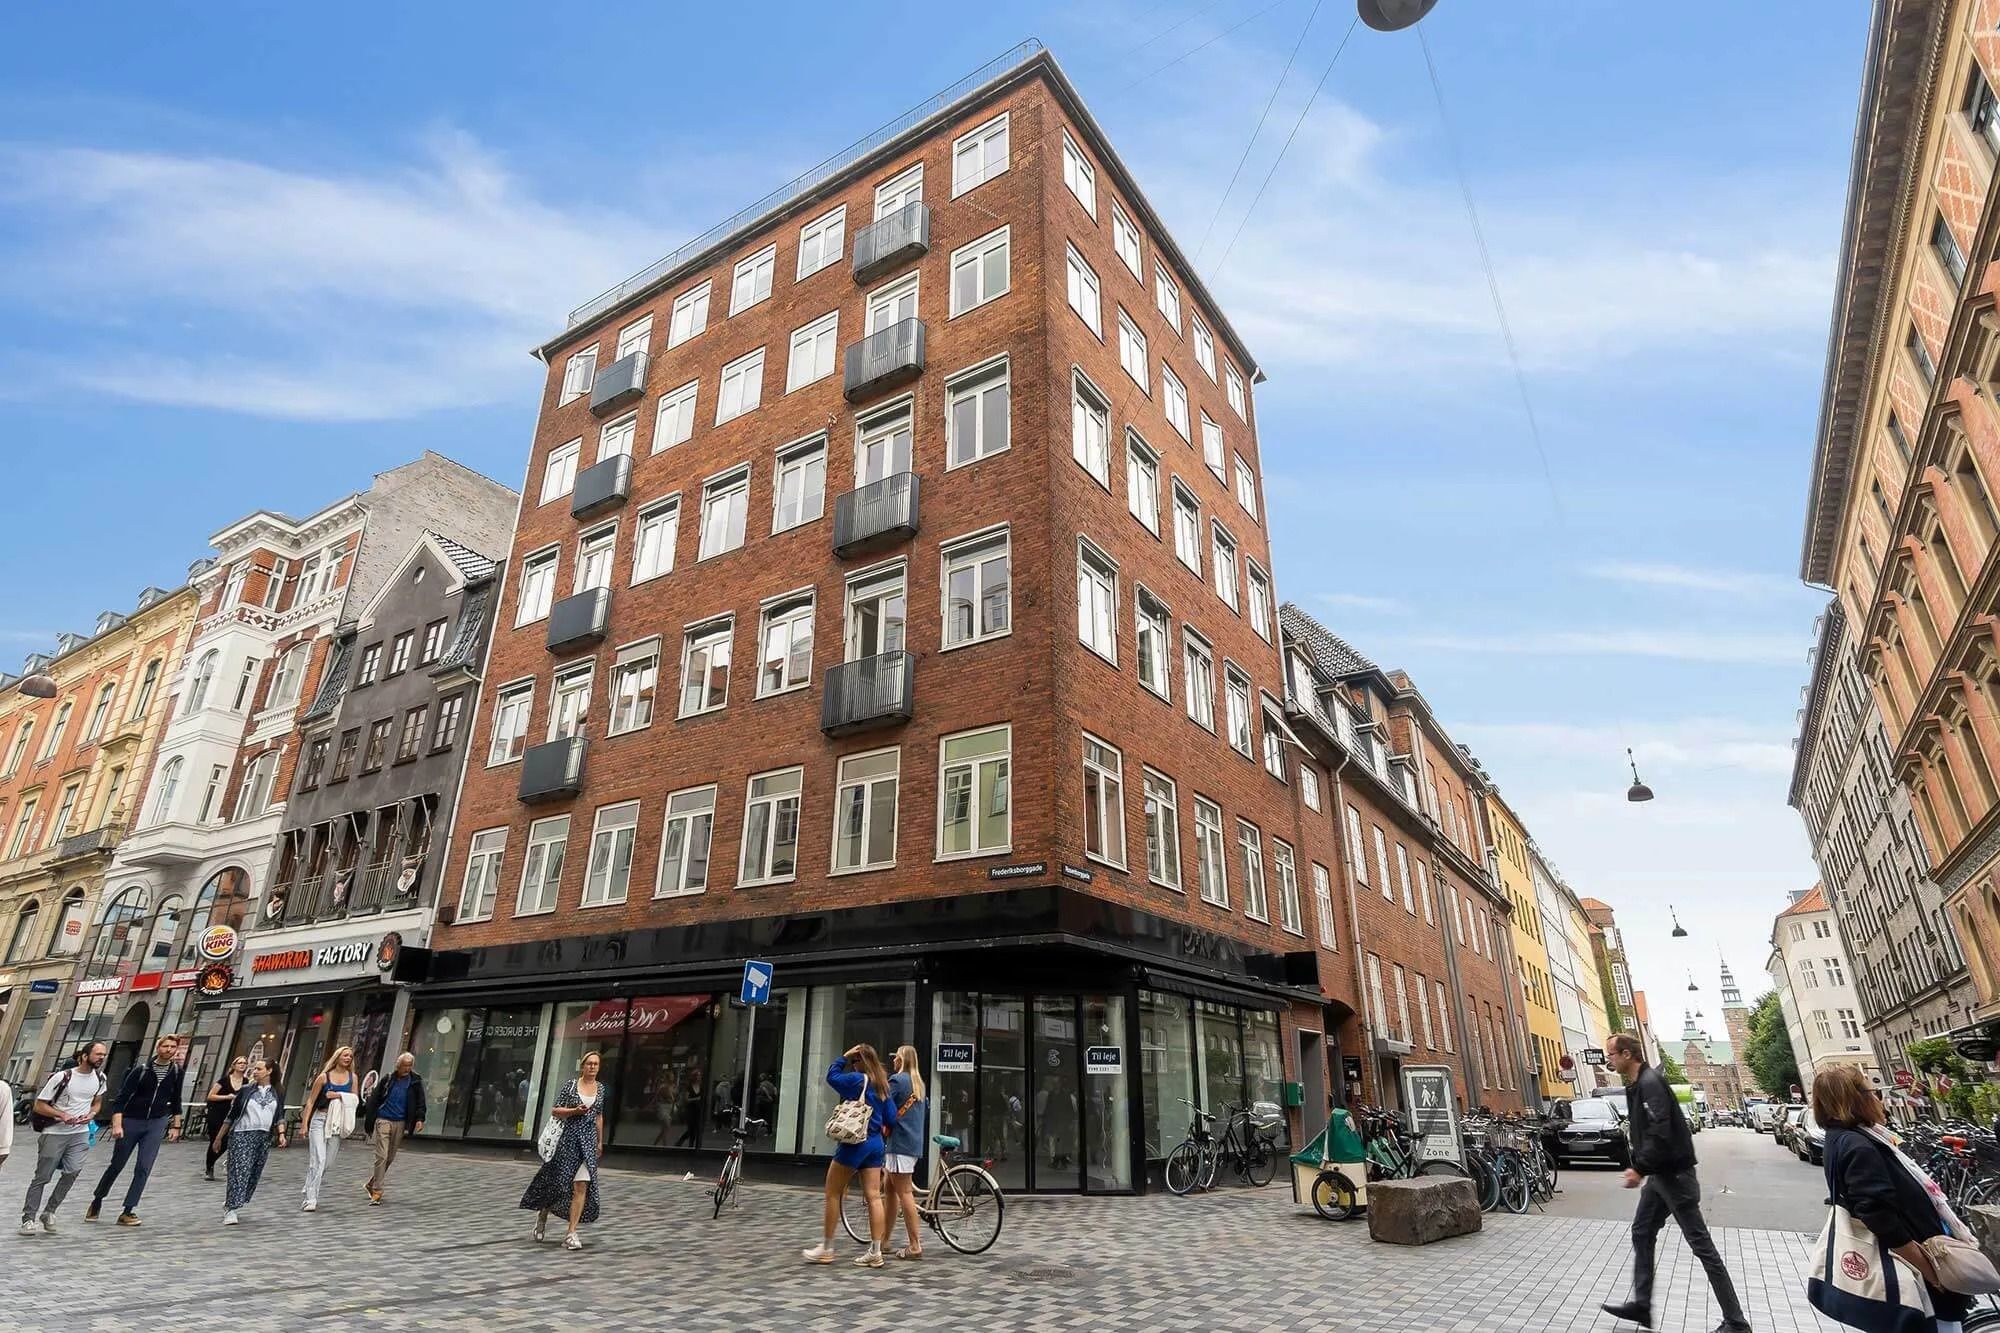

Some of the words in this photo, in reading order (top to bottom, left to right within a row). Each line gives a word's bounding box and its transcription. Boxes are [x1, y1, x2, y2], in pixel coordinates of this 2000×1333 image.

[991, 864, 1043, 877] Frederiksborggade
[206, 933, 234, 943] BURGER
[205, 939, 234, 950] KING
[252, 949, 312, 972] SHAWARMA
[316, 942, 372, 966] FACTORY
[78, 979, 104, 993] BURGER
[103, 977, 122, 990] KING
[943, 1049, 953, 1057] Til
[955, 1049, 968, 1060] leje
[1092, 1052, 1101, 1060] Til
[1103, 1052, 1117, 1062] leje
[1425, 1148, 1450, 1157] Zone
